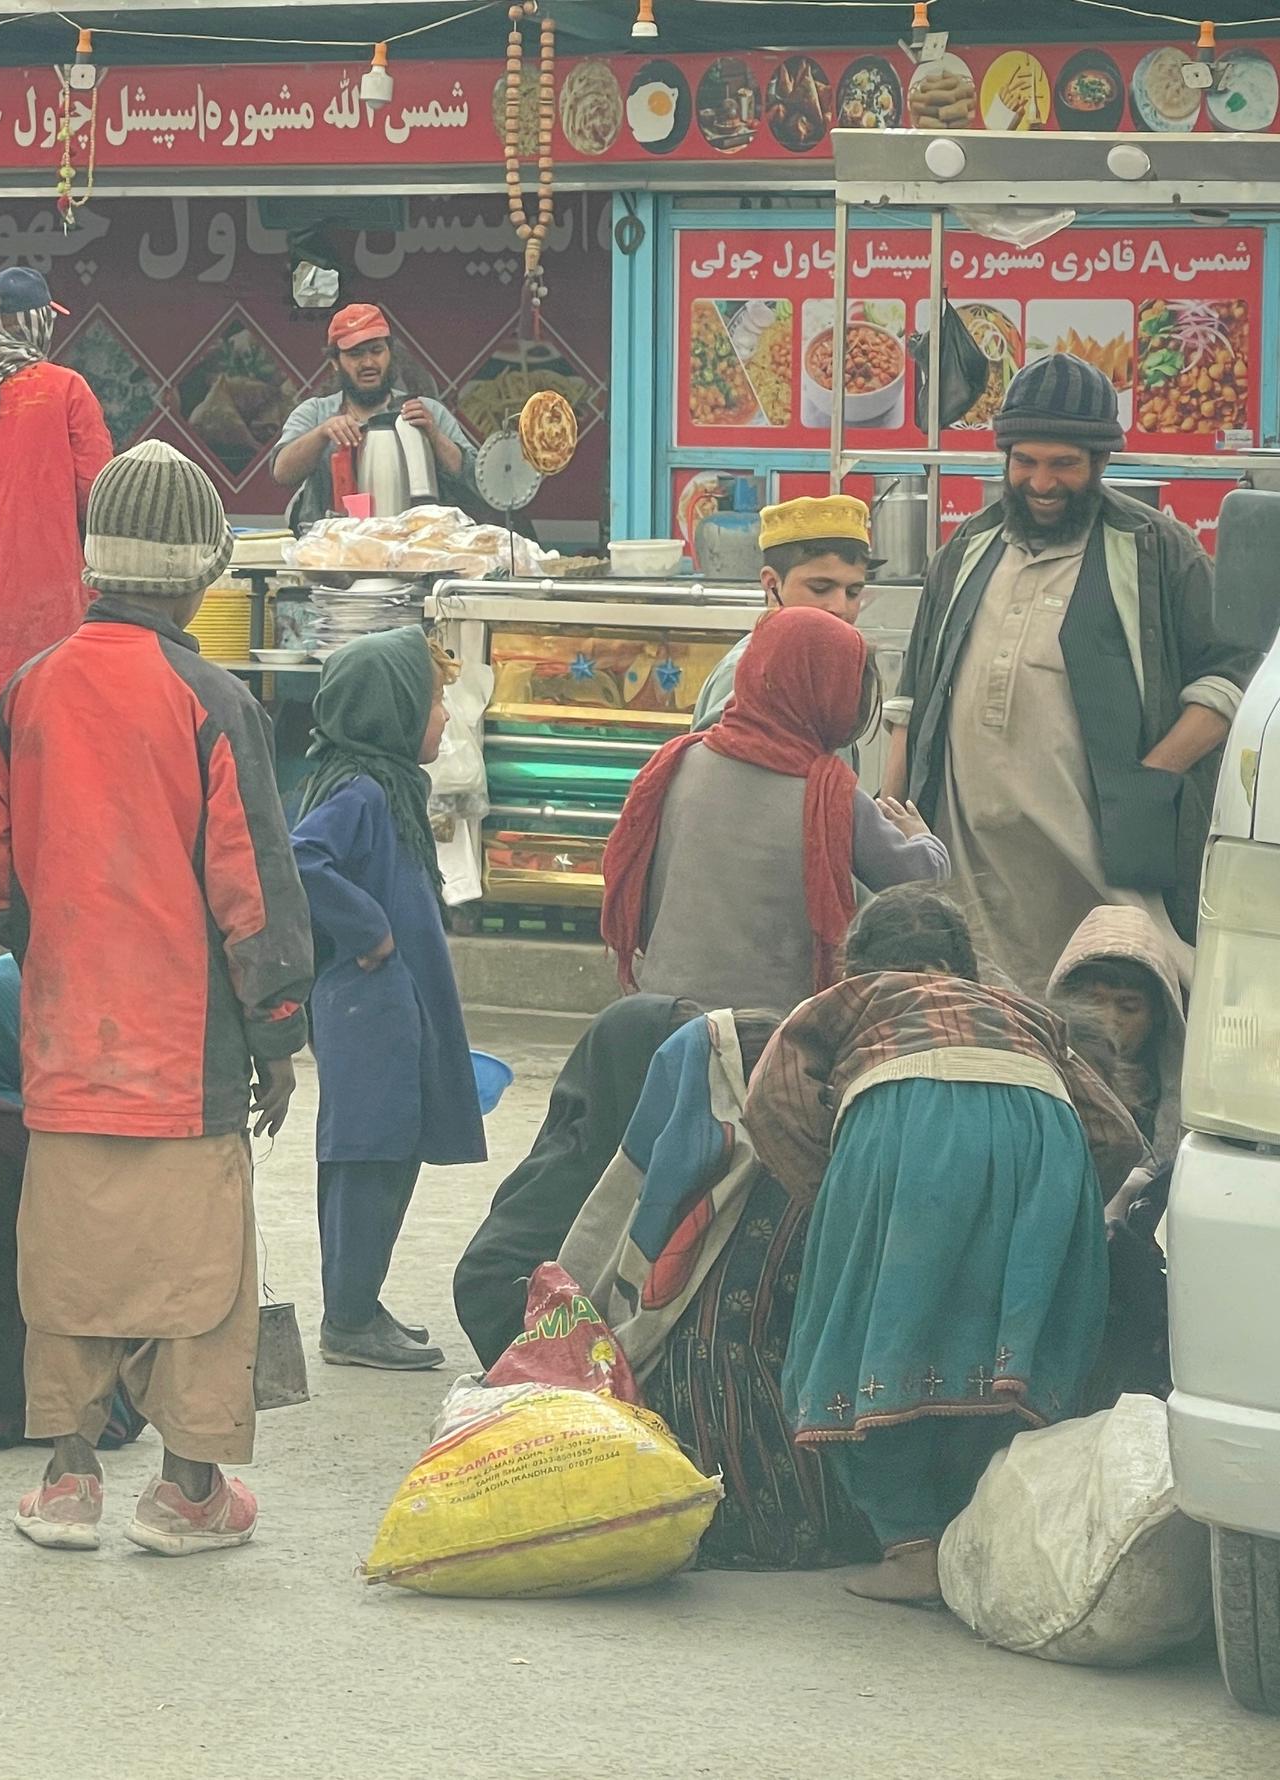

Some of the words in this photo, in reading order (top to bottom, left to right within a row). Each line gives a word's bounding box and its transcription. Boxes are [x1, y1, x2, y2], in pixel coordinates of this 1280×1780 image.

[384, 80, 468, 144] شمس
[690, 241, 763, 280] چولی
[1051, 239, 1135, 282] قادری
[1140, 240, 1170, 273] A
[1173, 240, 1251, 282] شمس
[409, 1471, 450, 1489] SYED
[455, 1447, 508, 1477] ZAMAN
[513, 1434, 554, 1454] SYED
